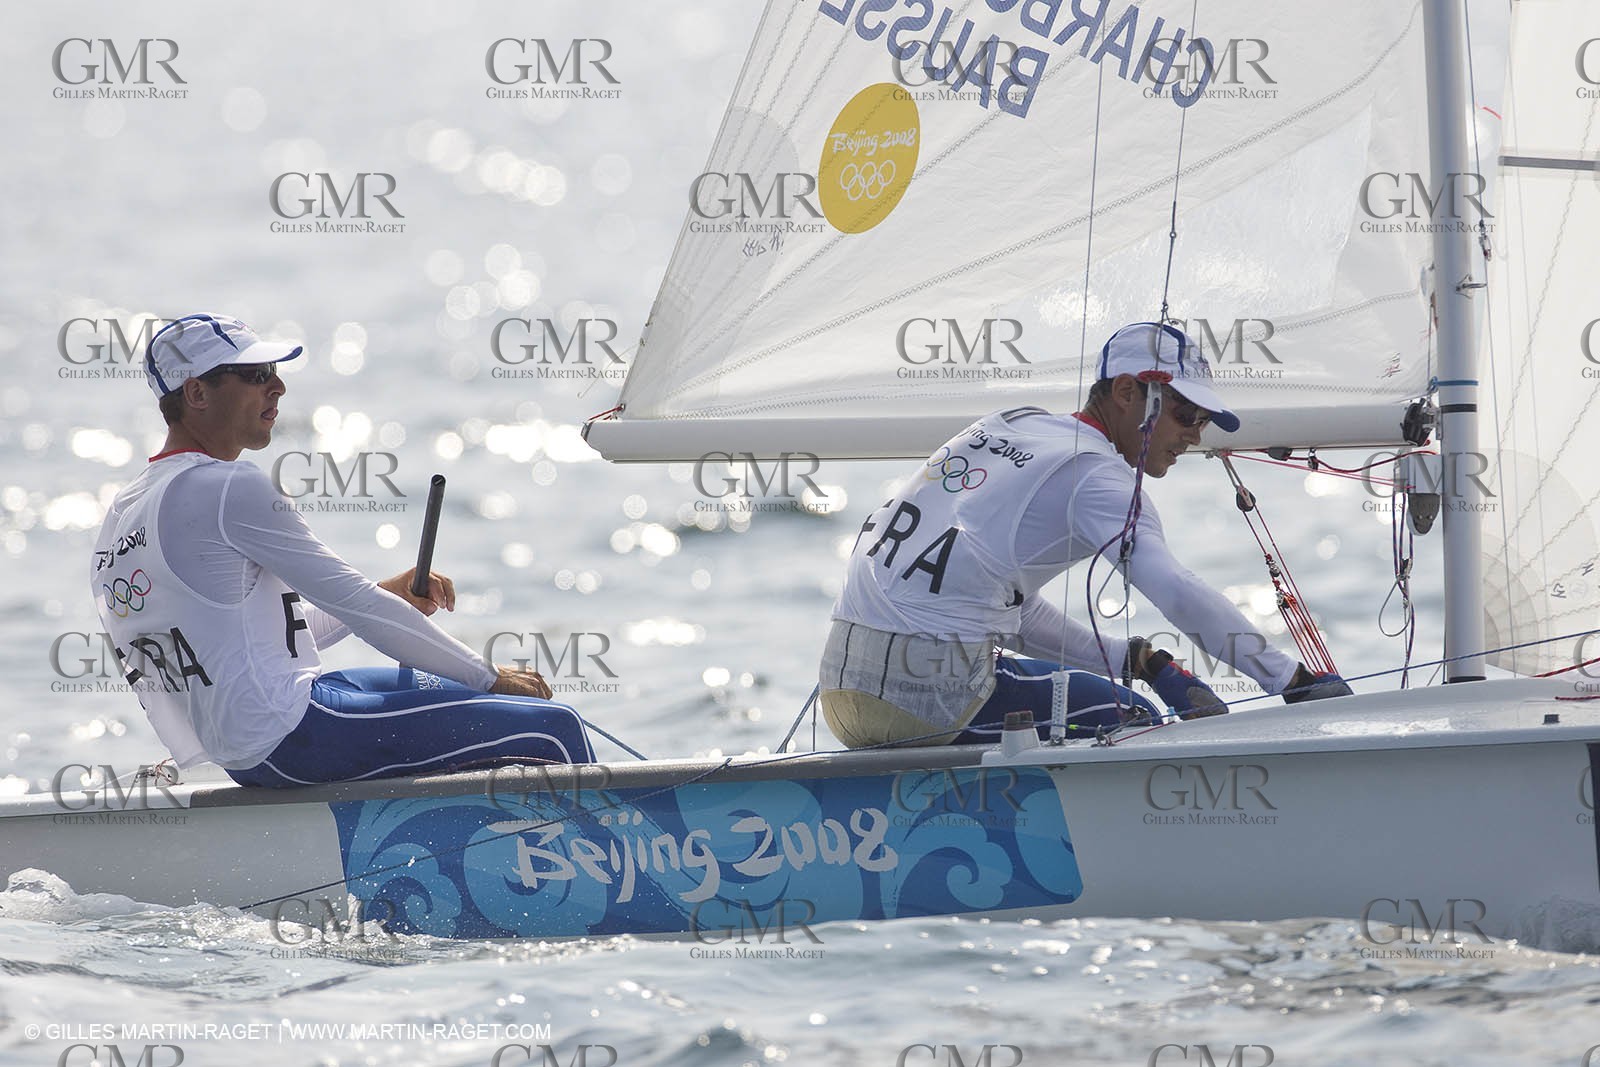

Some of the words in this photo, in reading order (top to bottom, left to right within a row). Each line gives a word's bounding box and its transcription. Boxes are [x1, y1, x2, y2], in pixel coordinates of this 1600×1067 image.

[831, 129, 878, 157] Beijing
[880, 127, 917, 148] 2008
[989, 438, 1034, 468] 2008
[117, 526, 147, 556] 2008
[486, 810, 720, 903] Beijing
[730, 807, 898, 876] 2008
